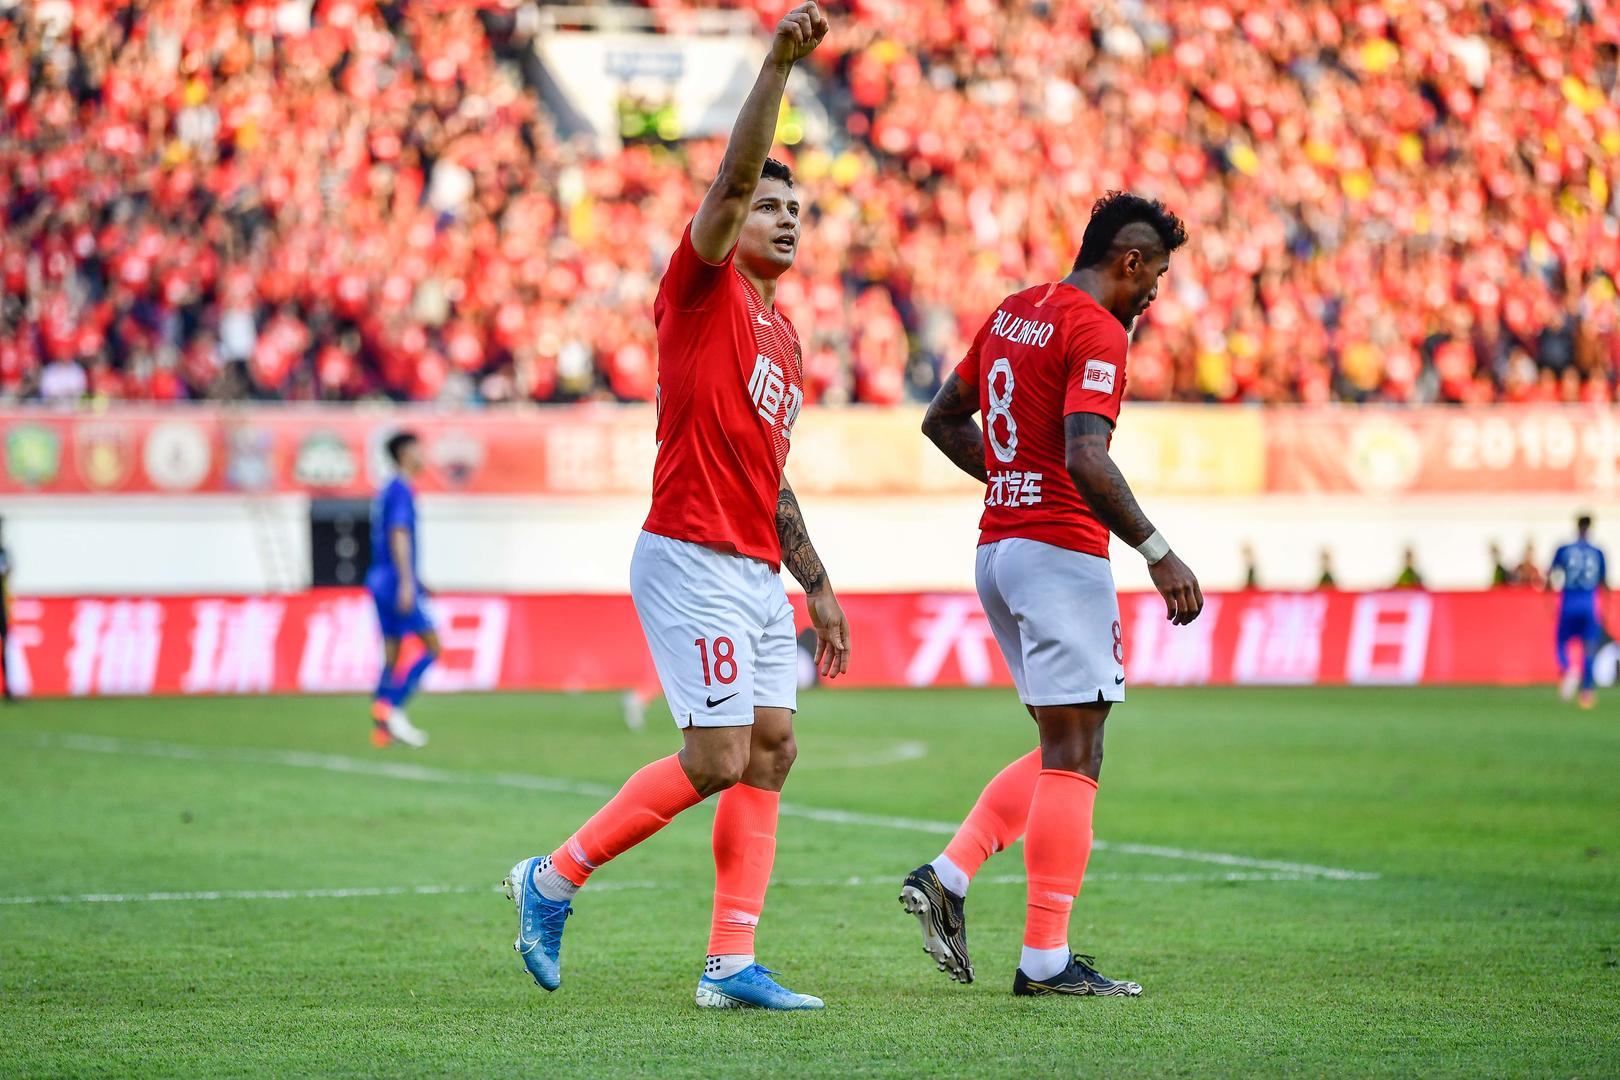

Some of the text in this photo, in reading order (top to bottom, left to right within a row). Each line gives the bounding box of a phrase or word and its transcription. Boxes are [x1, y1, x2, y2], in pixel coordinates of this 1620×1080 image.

[1087, 368, 1112, 385] 恒大
[987, 357, 1018, 463] 8
[1449, 416, 1575, 471] 2019
[694, 636, 738, 686] 18
[1111, 620, 1123, 666] 8
